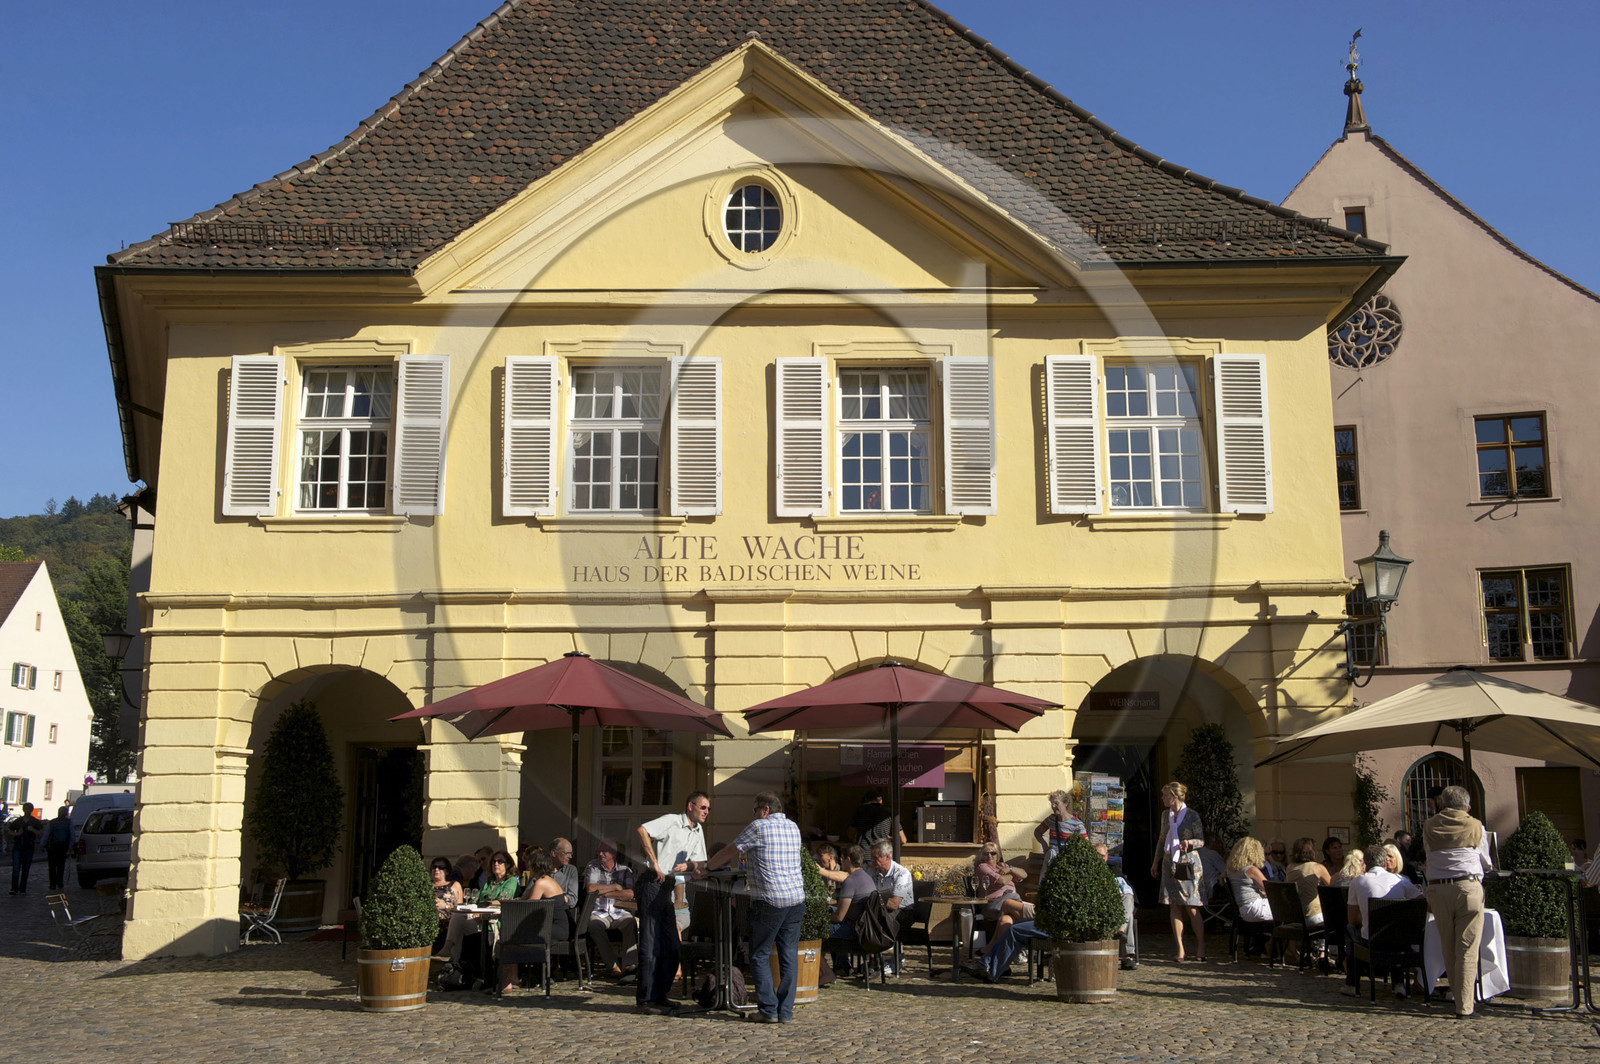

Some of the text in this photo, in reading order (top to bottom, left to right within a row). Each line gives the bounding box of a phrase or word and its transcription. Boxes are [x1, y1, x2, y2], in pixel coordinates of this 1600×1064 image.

[633, 535, 865, 560] ALTE WACHE
[572, 564, 921, 582] HAUS DER BADISCHEN WEINE
[866, 749, 919, 758] Flammchen
[866, 775, 889, 784] Neuer
